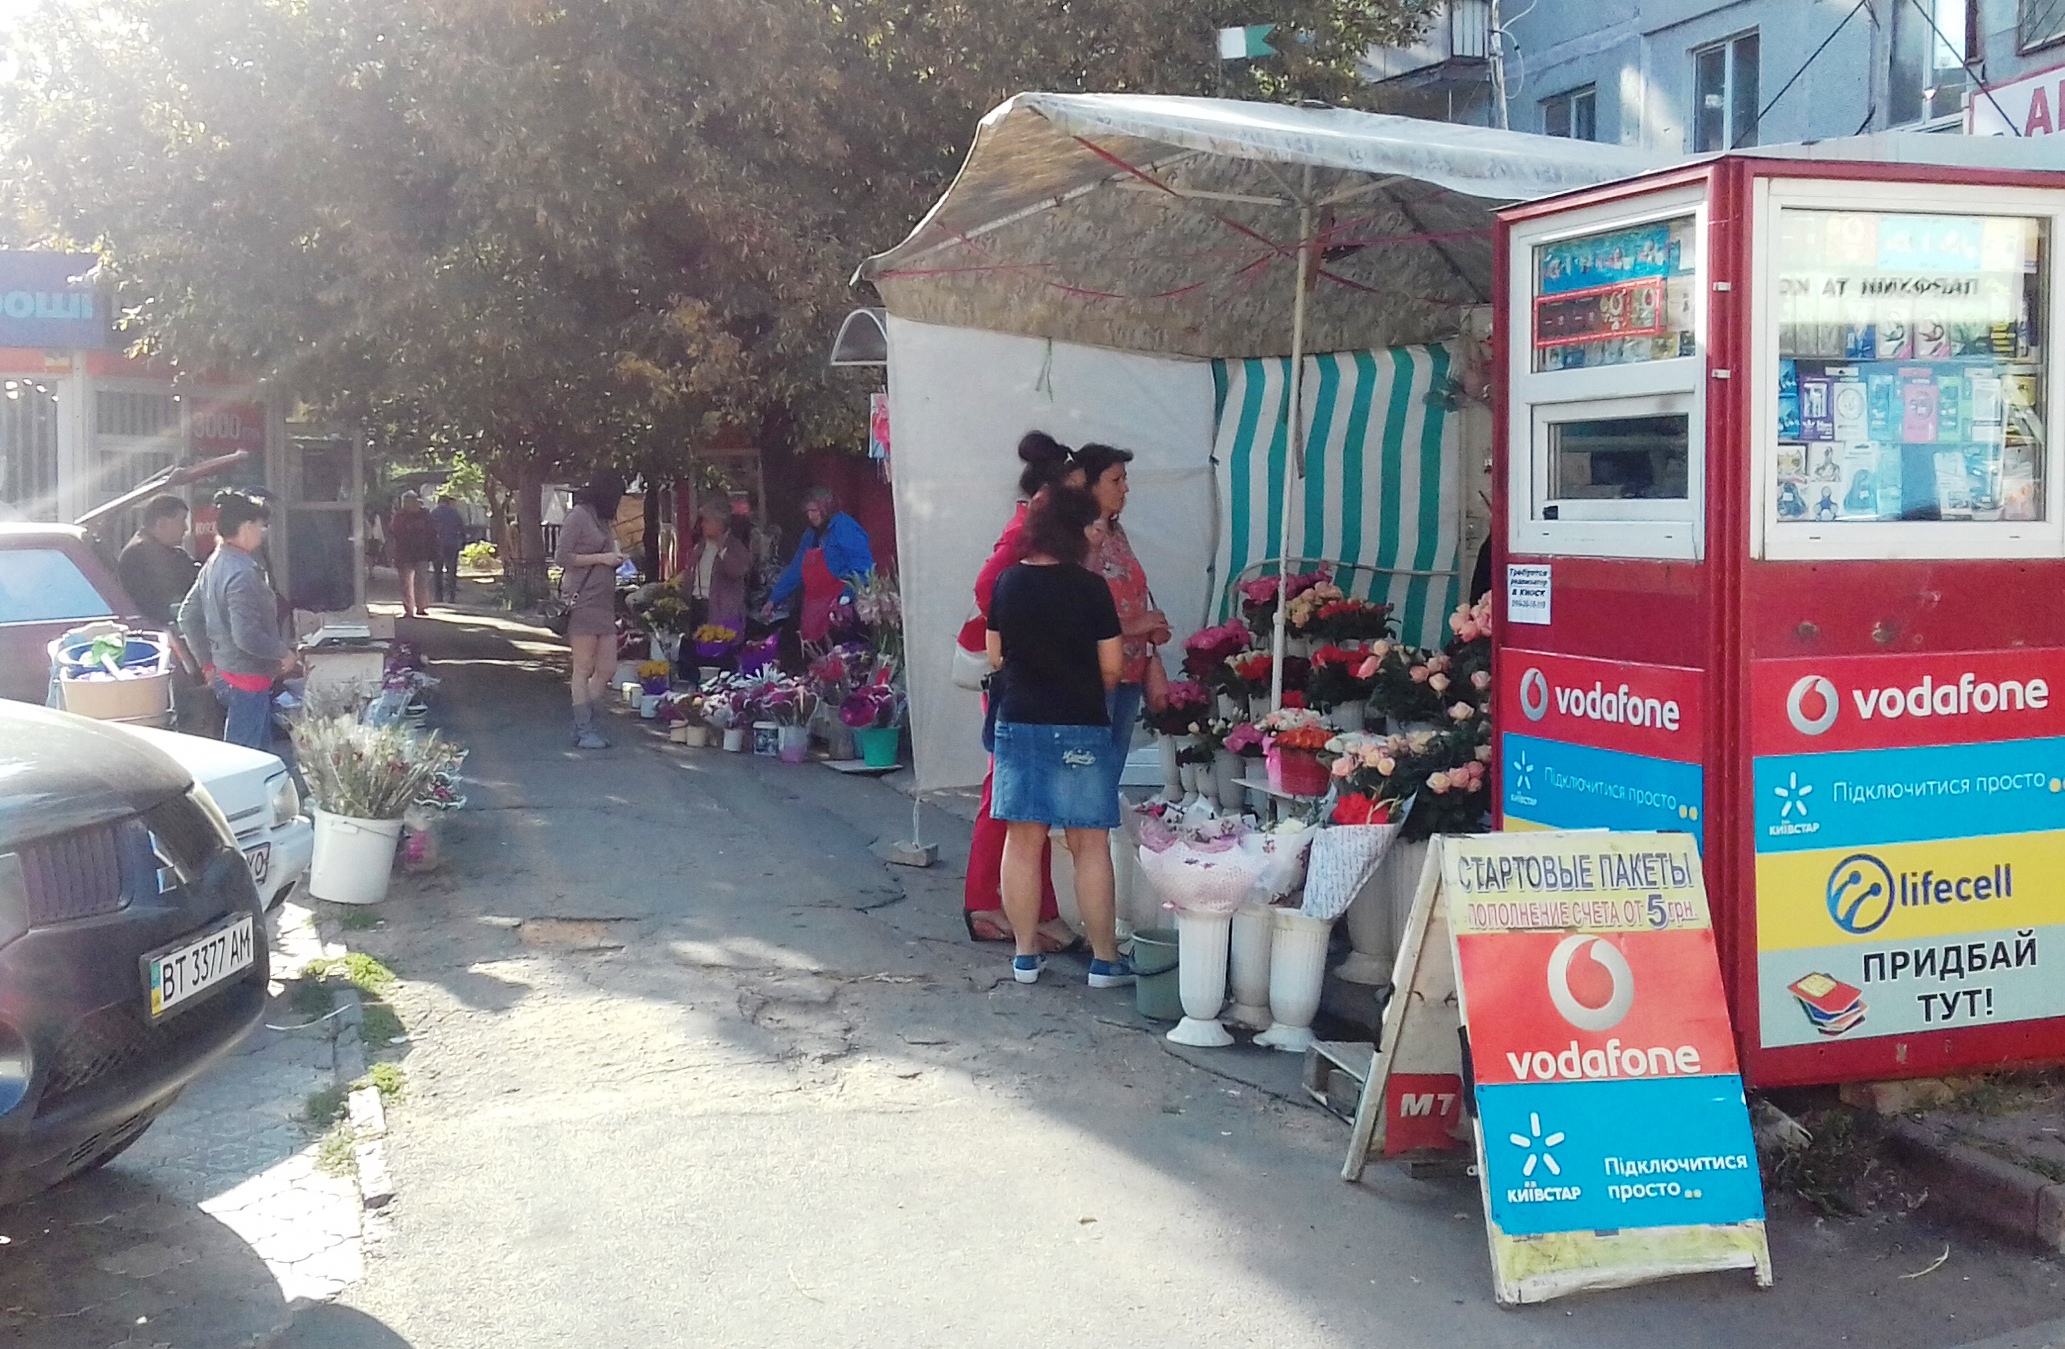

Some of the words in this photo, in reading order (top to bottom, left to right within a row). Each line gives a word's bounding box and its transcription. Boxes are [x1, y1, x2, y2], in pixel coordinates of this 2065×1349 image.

[2025, 80, 2065, 137] А
[0, 291, 93, 318] ОШІ
[1555, 681, 1680, 732] vodafone
[1852, 673, 2049, 721] vodafone
[1544, 766, 1626, 800] Підключитися
[1833, 777, 1970, 804] Підключитися
[1769, 819, 1820, 836] КИЇВСТАР
[1459, 855, 1596, 892] СТАРТОВЫЕ
[1600, 852, 1695, 889] ПАКЕТЫ
[1901, 863, 2012, 906] lifecell
[1468, 902, 1569, 928] ПОПОЛНЕНИЕ
[1572, 901, 1620, 927] СЧЕТА
[1623, 900, 1642, 926] ОТ
[1647, 894, 1669, 930] 5
[192, 936, 226, 986] 3377
[1863, 929, 2037, 982] ПРИДБАЙ
[1917, 988, 1993, 1022] ТУТ!
[1506, 1039, 1701, 1080] vodafone
[1604, 1154, 1749, 1177] Підключитися
[1507, 1181, 1582, 1203] КИЇВСТАР
